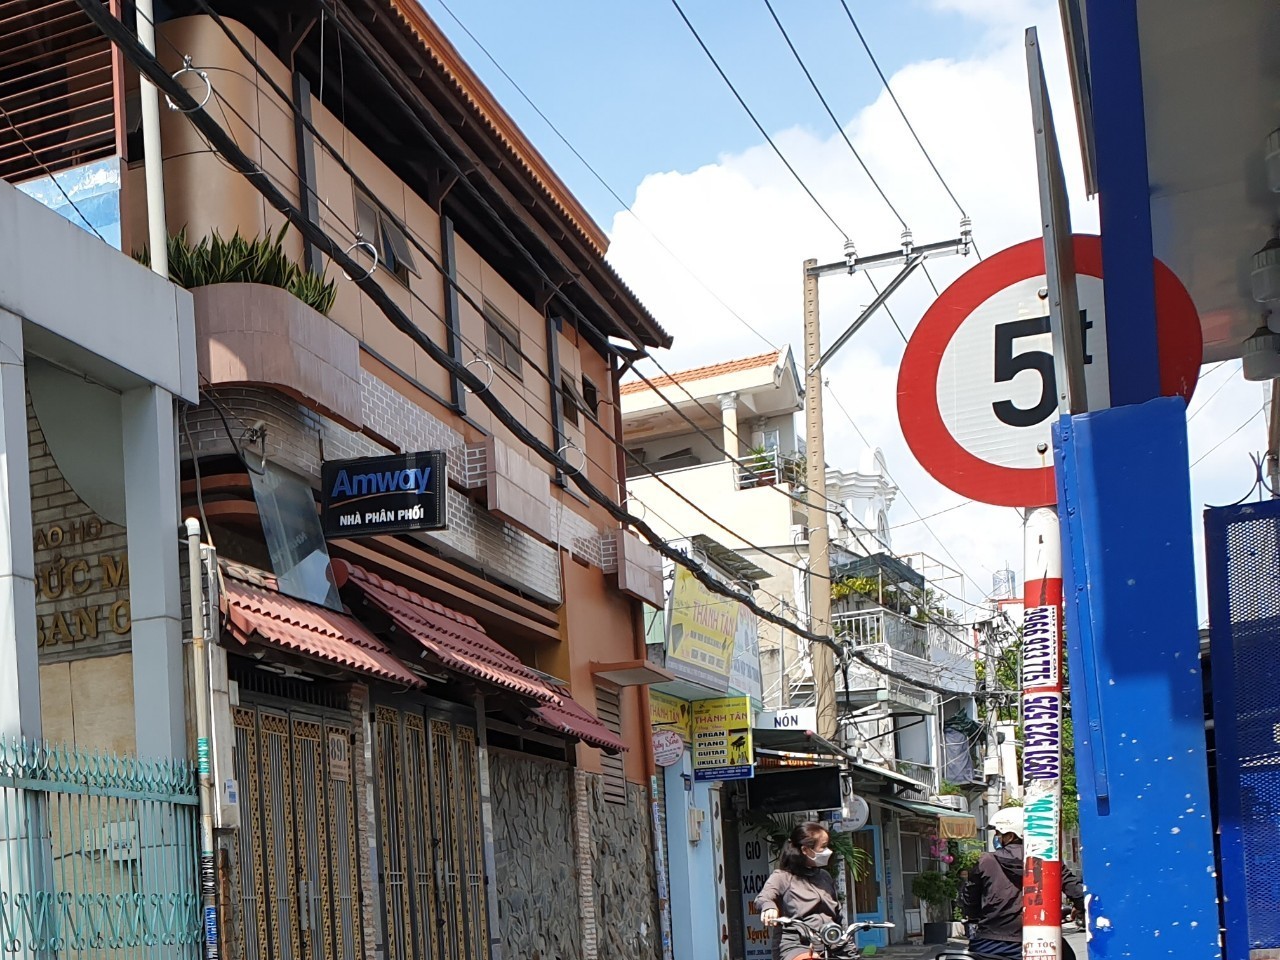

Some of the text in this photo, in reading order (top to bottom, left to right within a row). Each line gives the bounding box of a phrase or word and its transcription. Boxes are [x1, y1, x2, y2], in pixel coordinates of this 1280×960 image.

[331, 467, 431, 497] Amway
[340, 504, 424, 526] NHÀ PHÂN PHỐI
[774, 712, 799, 728] NÓN
[697, 731, 725, 739] ORGAN
[331, 737, 346, 762] 891
[697, 758, 726, 766] UKULELE
